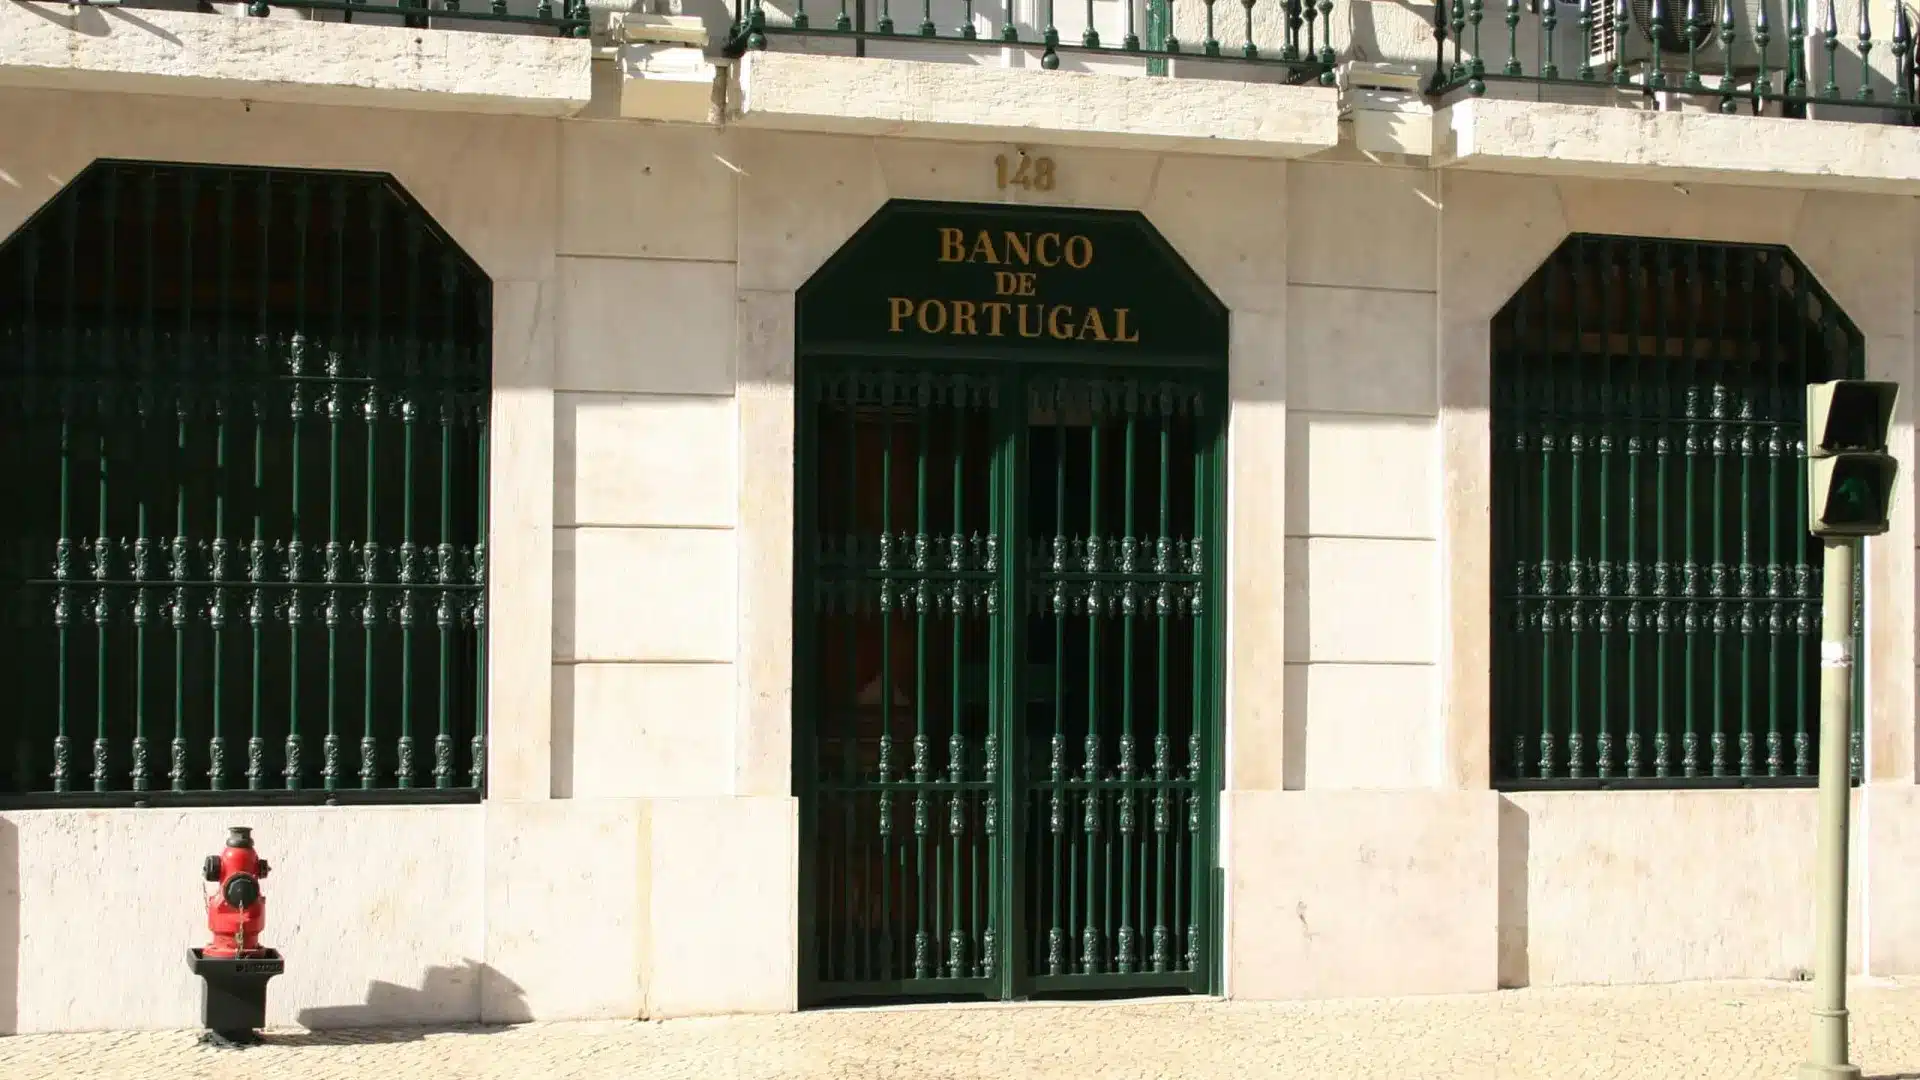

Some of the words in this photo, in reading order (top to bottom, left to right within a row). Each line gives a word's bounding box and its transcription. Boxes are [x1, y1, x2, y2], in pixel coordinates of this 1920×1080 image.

[994, 154, 1056, 190] 148
[938, 228, 1093, 268] BANCO
[995, 272, 1036, 296] DE
[888, 298, 1139, 342] PORTUGAL
